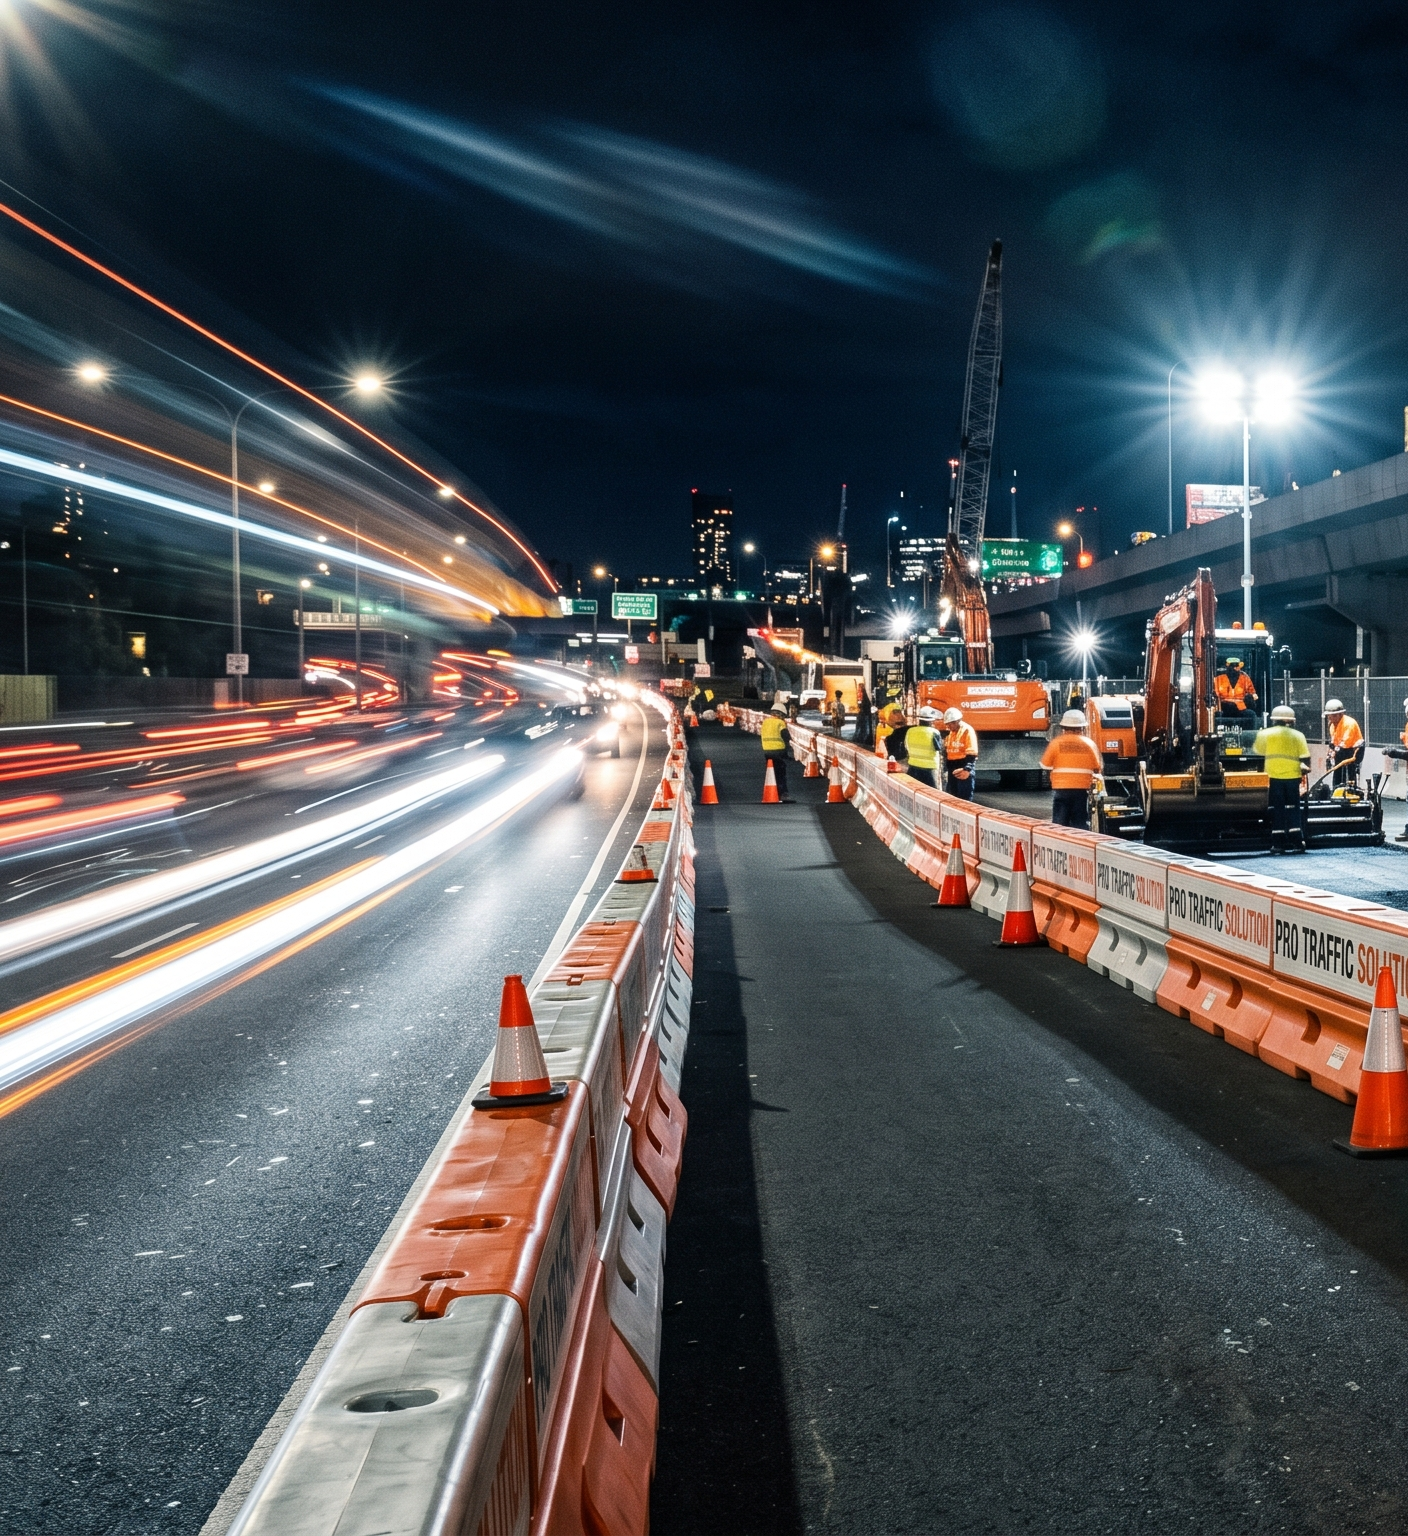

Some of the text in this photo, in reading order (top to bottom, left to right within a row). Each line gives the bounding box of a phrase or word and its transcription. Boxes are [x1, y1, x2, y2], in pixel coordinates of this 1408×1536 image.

[1110, 866, 1135, 901] TRAFFIC
[1135, 874, 1165, 912] SOLUTION
[1169, 885, 1269, 949] PRO TRAFFIC SOLUTION
[1275, 918, 1299, 959] PRO
[1302, 926, 1354, 980] TRAFFIC
